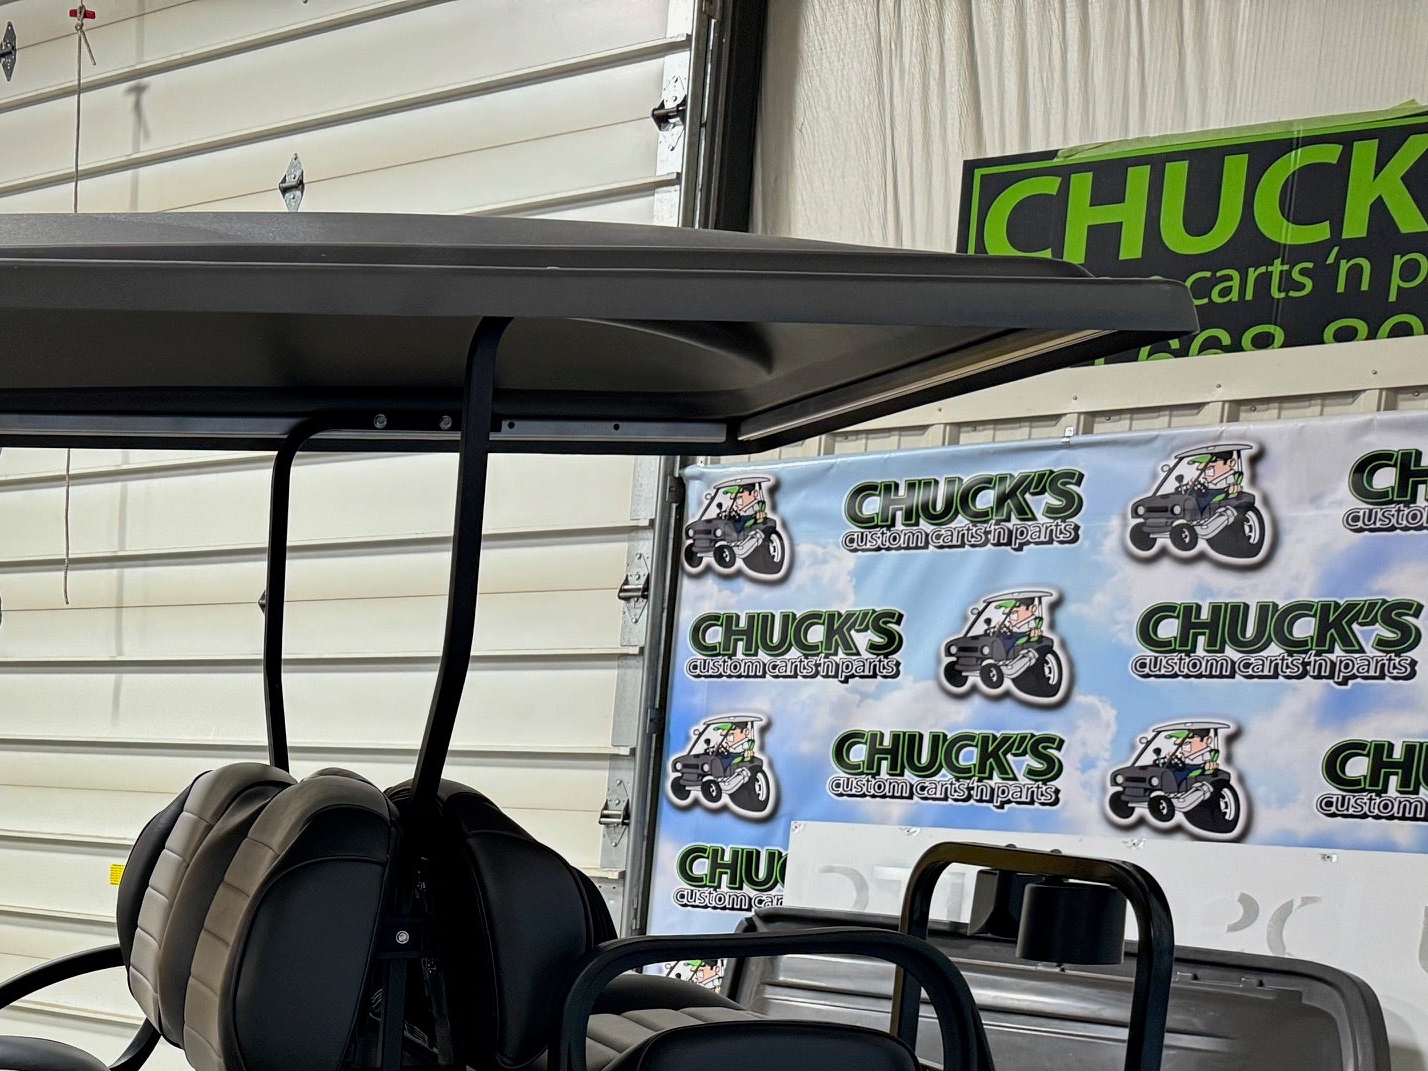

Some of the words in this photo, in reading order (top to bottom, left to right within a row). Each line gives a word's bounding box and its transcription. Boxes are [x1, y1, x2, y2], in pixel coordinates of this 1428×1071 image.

[1185, 257, 1315, 306] carts
[844, 469, 1084, 528] CHUCK'S
[1342, 503, 1428, 533] custo
[843, 527, 927, 551] custom
[929, 524, 987, 547] carts
[1012, 521, 1077, 550] parts
[689, 608, 905, 657] CHUCK'S
[1136, 598, 1424, 654] CHUCK'S
[687, 656, 763, 678] custom
[766, 656, 815, 677] carts
[839, 656, 899, 683] parts
[1132, 654, 1232, 678] custom
[1235, 654, 1305, 678] carts
[1335, 655, 1415, 685] parts
[832, 730, 1065, 782] CHUCK'S
[1321, 739, 1428, 795] CH
[829, 776, 911, 798] custom
[914, 777, 966, 798] carts
[993, 781, 1059, 808] parts
[1316, 792, 1428, 821] custom
[673, 888, 752, 911] custom
[753, 893, 783, 909] car
